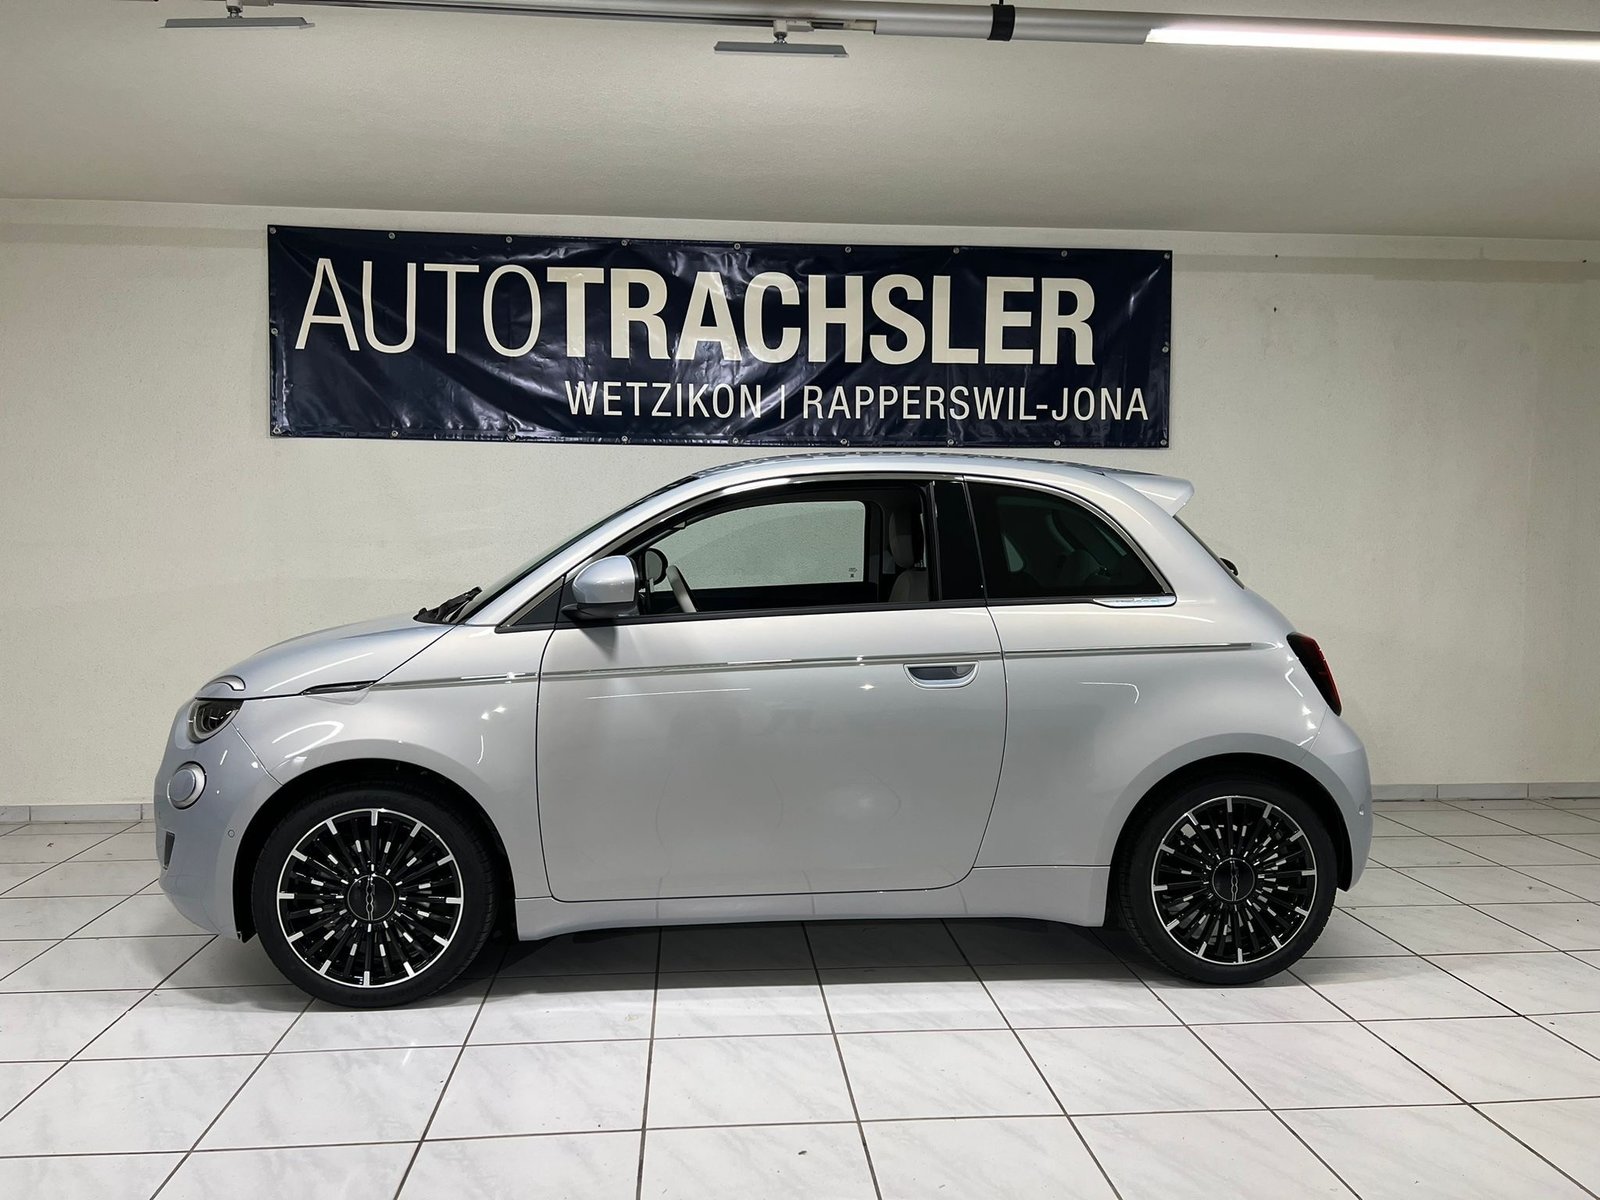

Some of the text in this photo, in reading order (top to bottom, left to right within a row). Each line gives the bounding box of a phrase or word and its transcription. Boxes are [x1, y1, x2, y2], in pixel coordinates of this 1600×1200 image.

[295, 258, 1095, 365] AUTOTRACHSLER
[565, 381, 761, 419] WETZIKON
[803, 385, 1149, 421] RAPPERSWIL-JONA
